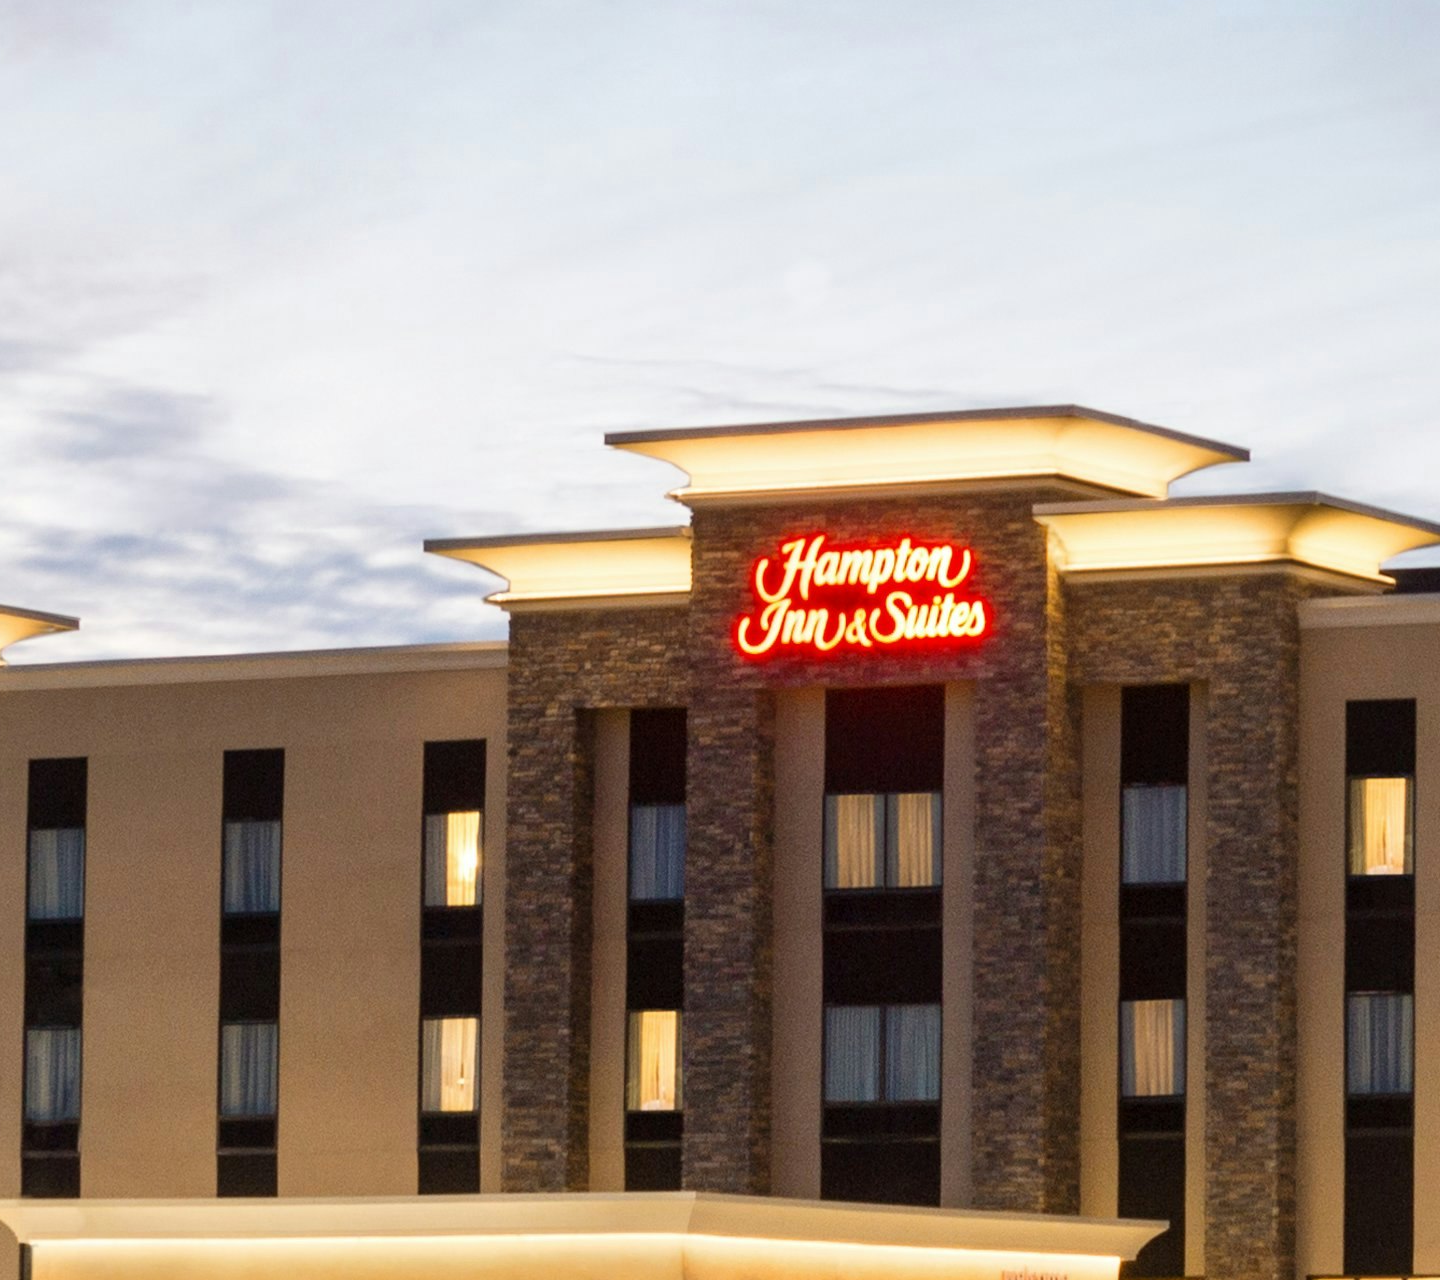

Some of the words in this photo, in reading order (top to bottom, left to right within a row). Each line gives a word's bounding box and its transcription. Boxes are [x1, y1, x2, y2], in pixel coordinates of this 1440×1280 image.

[755, 534, 972, 603] Hampton
[737, 598, 847, 654] Inn
[845, 607, 872, 648] &
[869, 591, 986, 644] Suites
